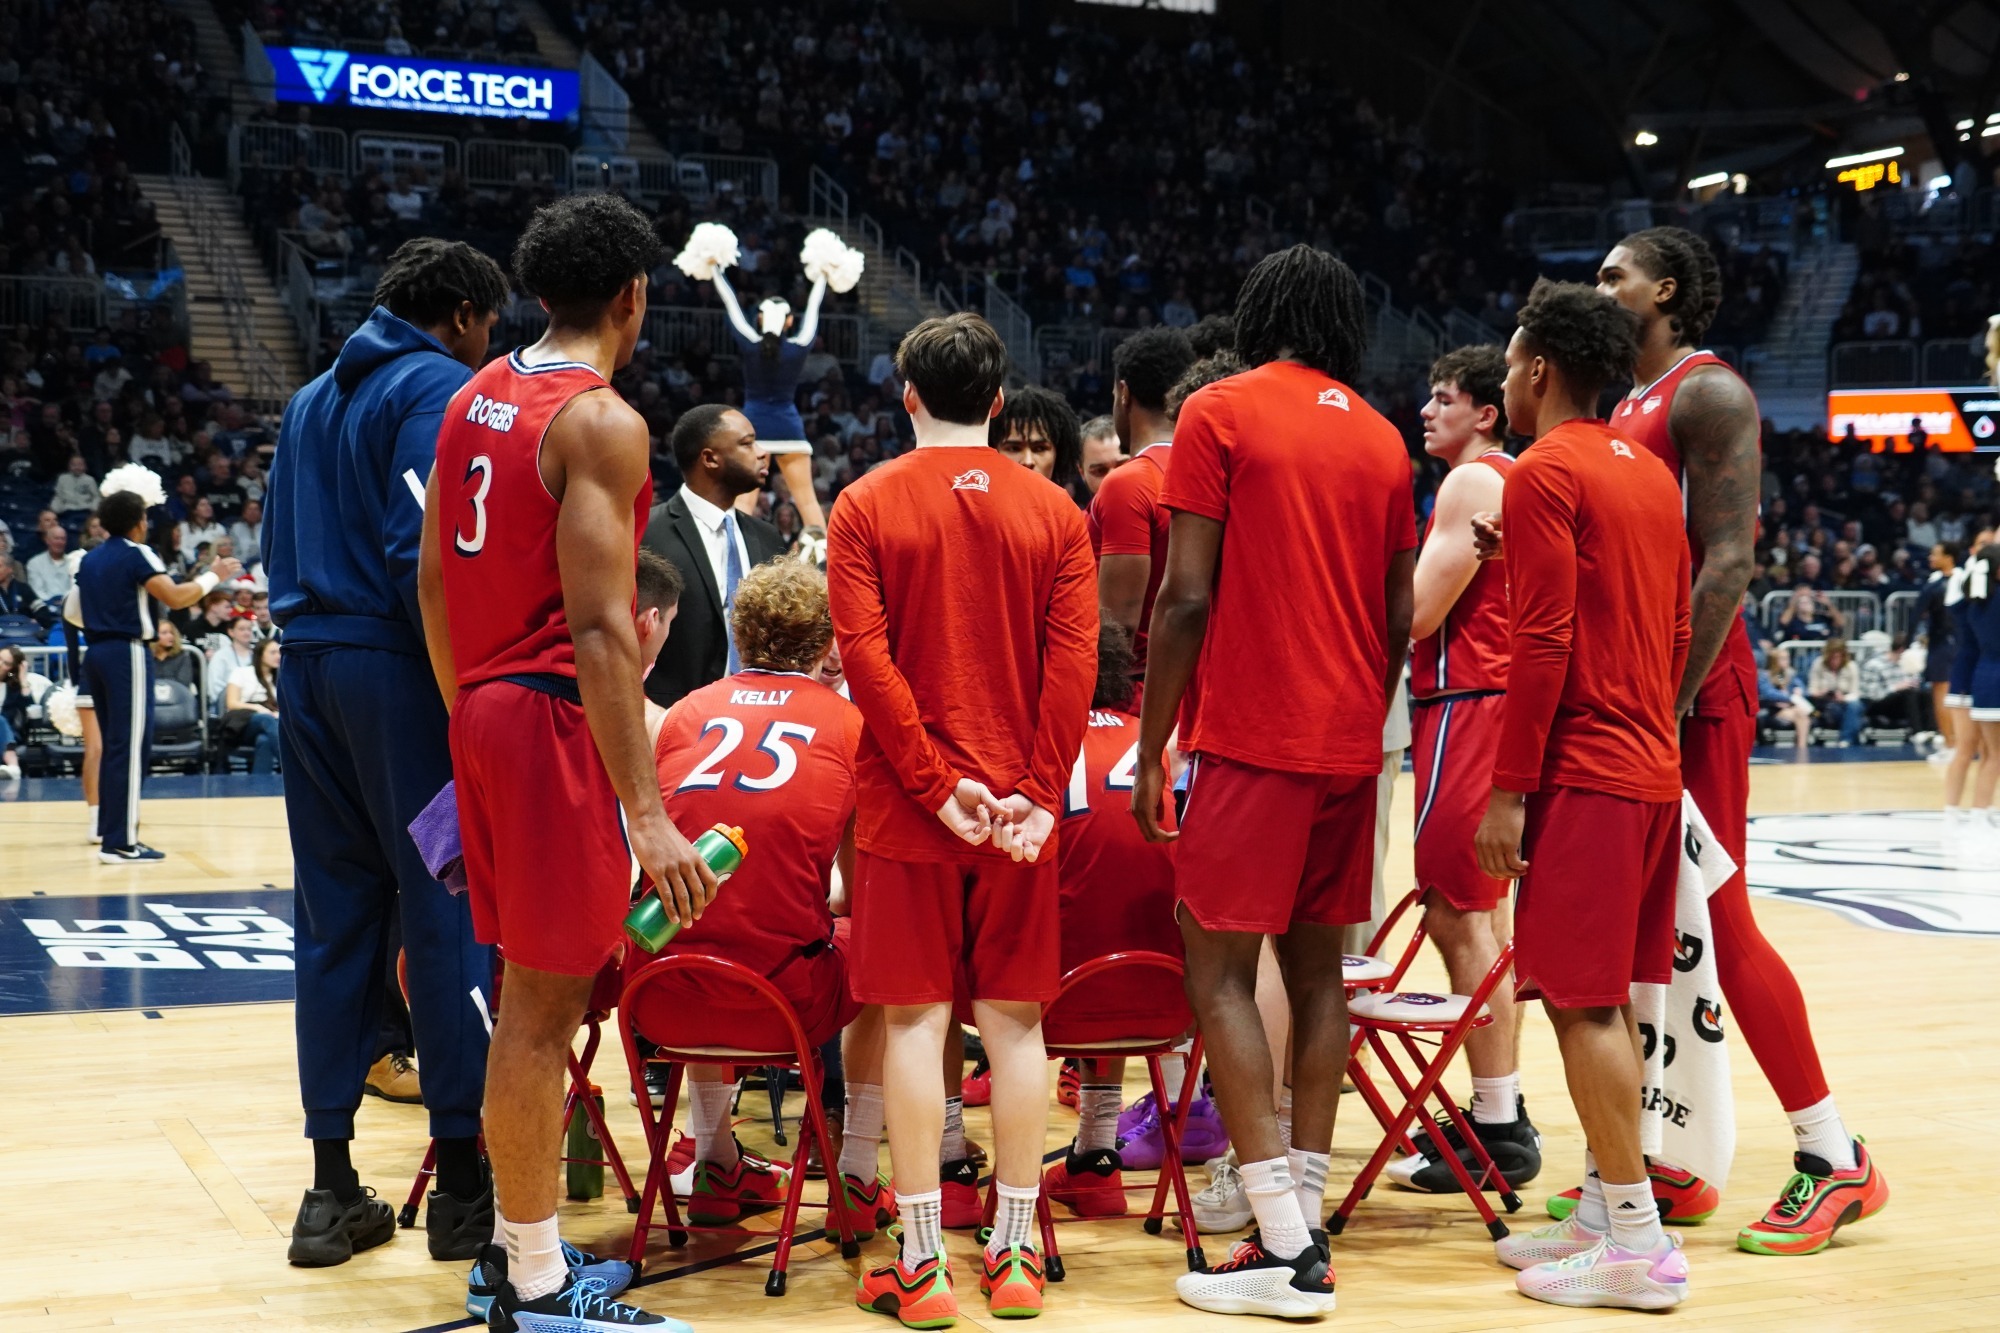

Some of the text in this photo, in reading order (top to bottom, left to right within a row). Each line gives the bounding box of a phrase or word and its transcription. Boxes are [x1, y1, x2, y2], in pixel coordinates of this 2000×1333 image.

[350, 63, 552, 110] FORCE.TECH
[465, 392, 519, 433] ROGERS
[454, 453, 493, 559] 3
[729, 689, 793, 706] KELLY
[672, 716, 817, 796] 25
[1641, 1086, 1692, 1129] ADE
